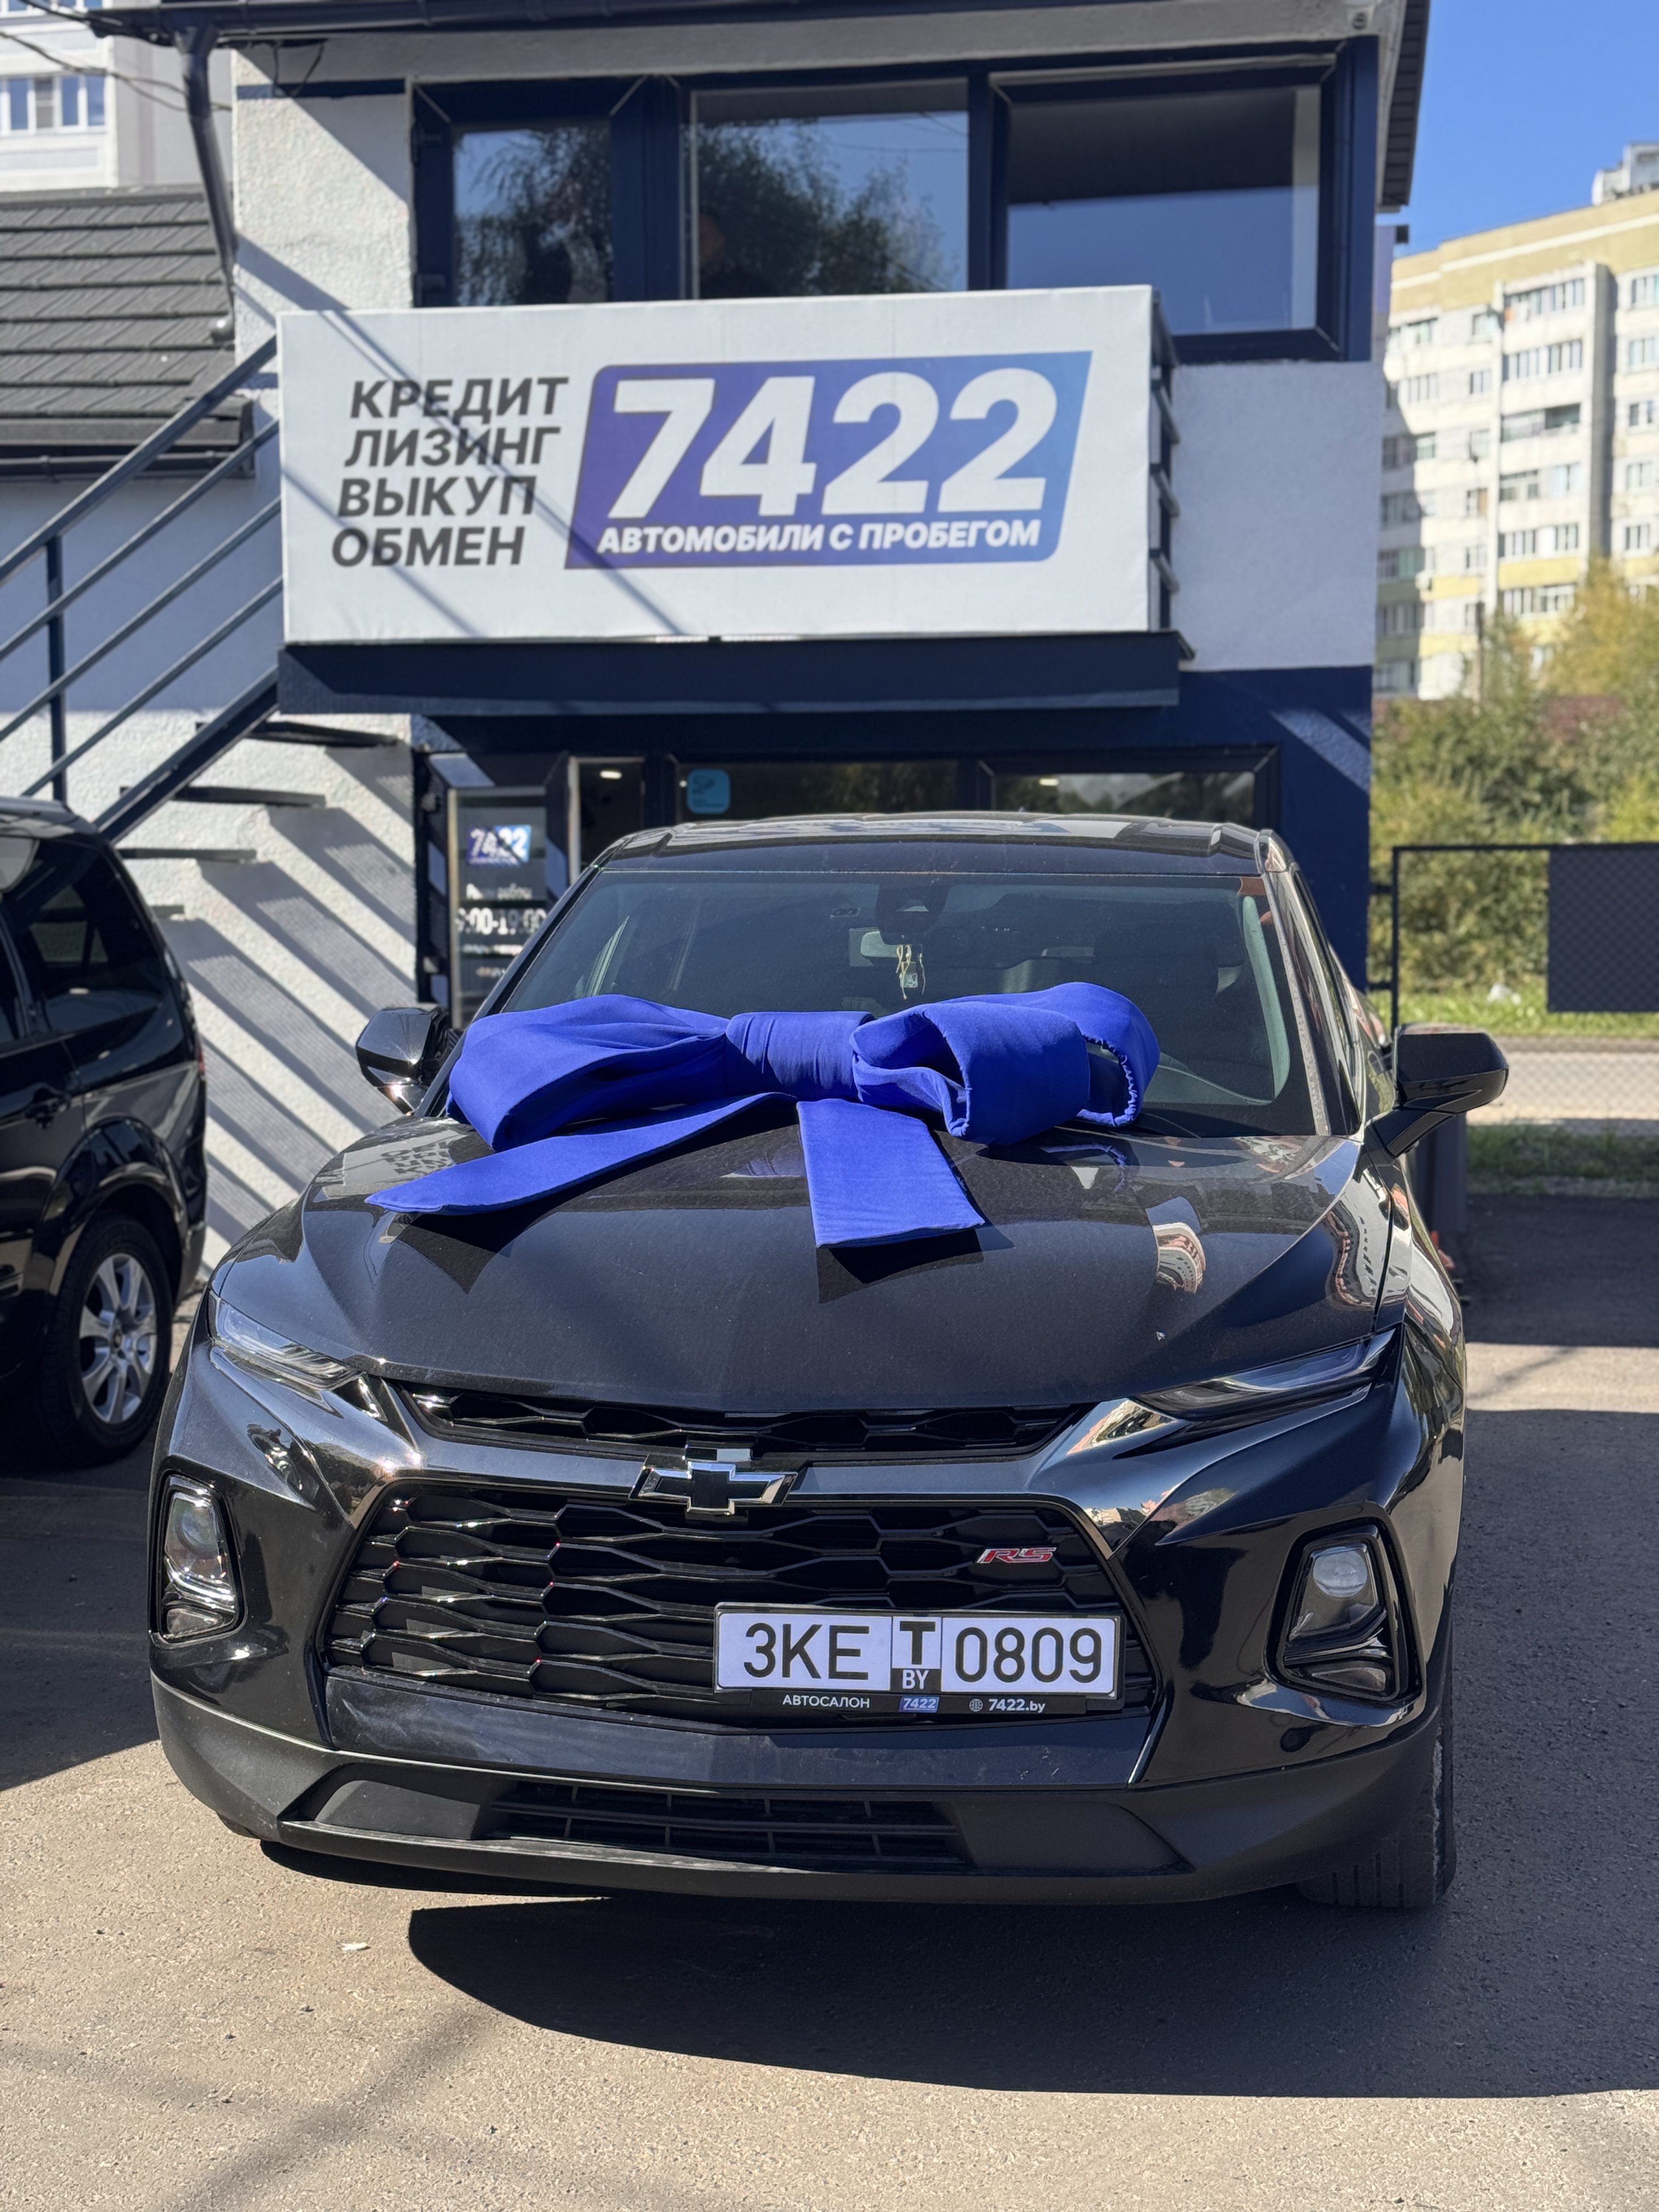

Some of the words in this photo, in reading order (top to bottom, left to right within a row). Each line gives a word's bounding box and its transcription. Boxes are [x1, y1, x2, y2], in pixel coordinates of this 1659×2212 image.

[350, 376, 569, 425] КРЕДИТ
[344, 426, 561, 467] ЛИЗИНГ
[607, 367, 1058, 519] 7422
[338, 475, 537, 517] ВЫКУП
[331, 526, 526, 568] ОБМЕН
[596, 524, 825, 554] АВТОМОБИЛИ
[828, 523, 854, 551] С
[858, 519, 1042, 550] ПРОБЕГОМ
[470, 827, 528, 858] 7422
[976, 1547, 1057, 1564] RS
[743, 1622, 871, 1680] 3KE
[900, 1621, 936, 1665] T
[955, 1627, 1102, 1683] 0809
[902, 1669, 929, 1690] BY
[782, 1694, 870, 1708] АВТОСАЛОН
[902, 1697, 936, 1709] 7422
[988, 1699, 1046, 1714] 7422.by
